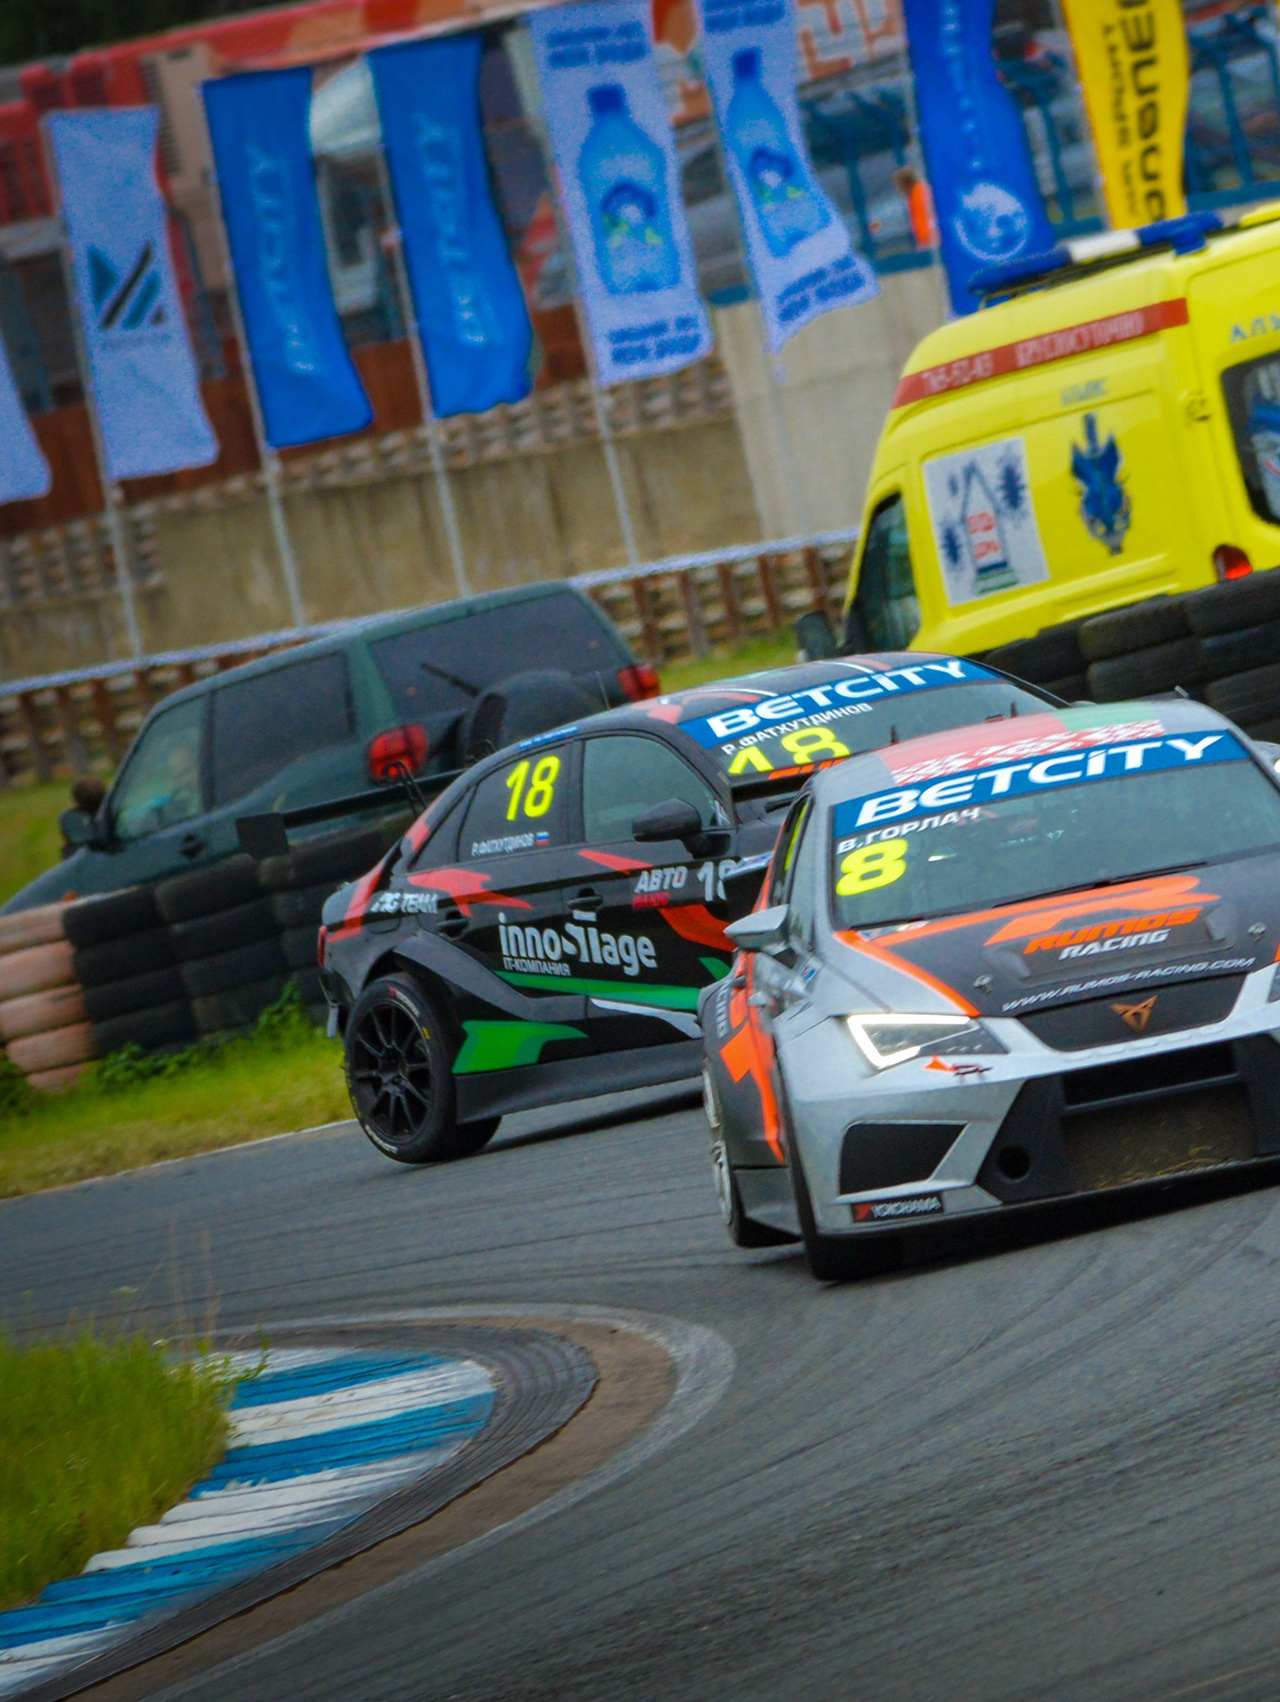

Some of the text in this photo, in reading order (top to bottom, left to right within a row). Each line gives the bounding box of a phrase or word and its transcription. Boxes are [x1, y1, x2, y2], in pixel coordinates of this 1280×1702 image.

[728, 726, 851, 776] 18
[506, 755, 561, 821] 18
[836, 807, 981, 854] В.ГОРЛАЧ
[634, 865, 688, 894] АВТО
[836, 839, 909, 896] 8
[1059, 929, 1171, 960] RACING
[870, 1196, 942, 1218] YOKOHAMA
